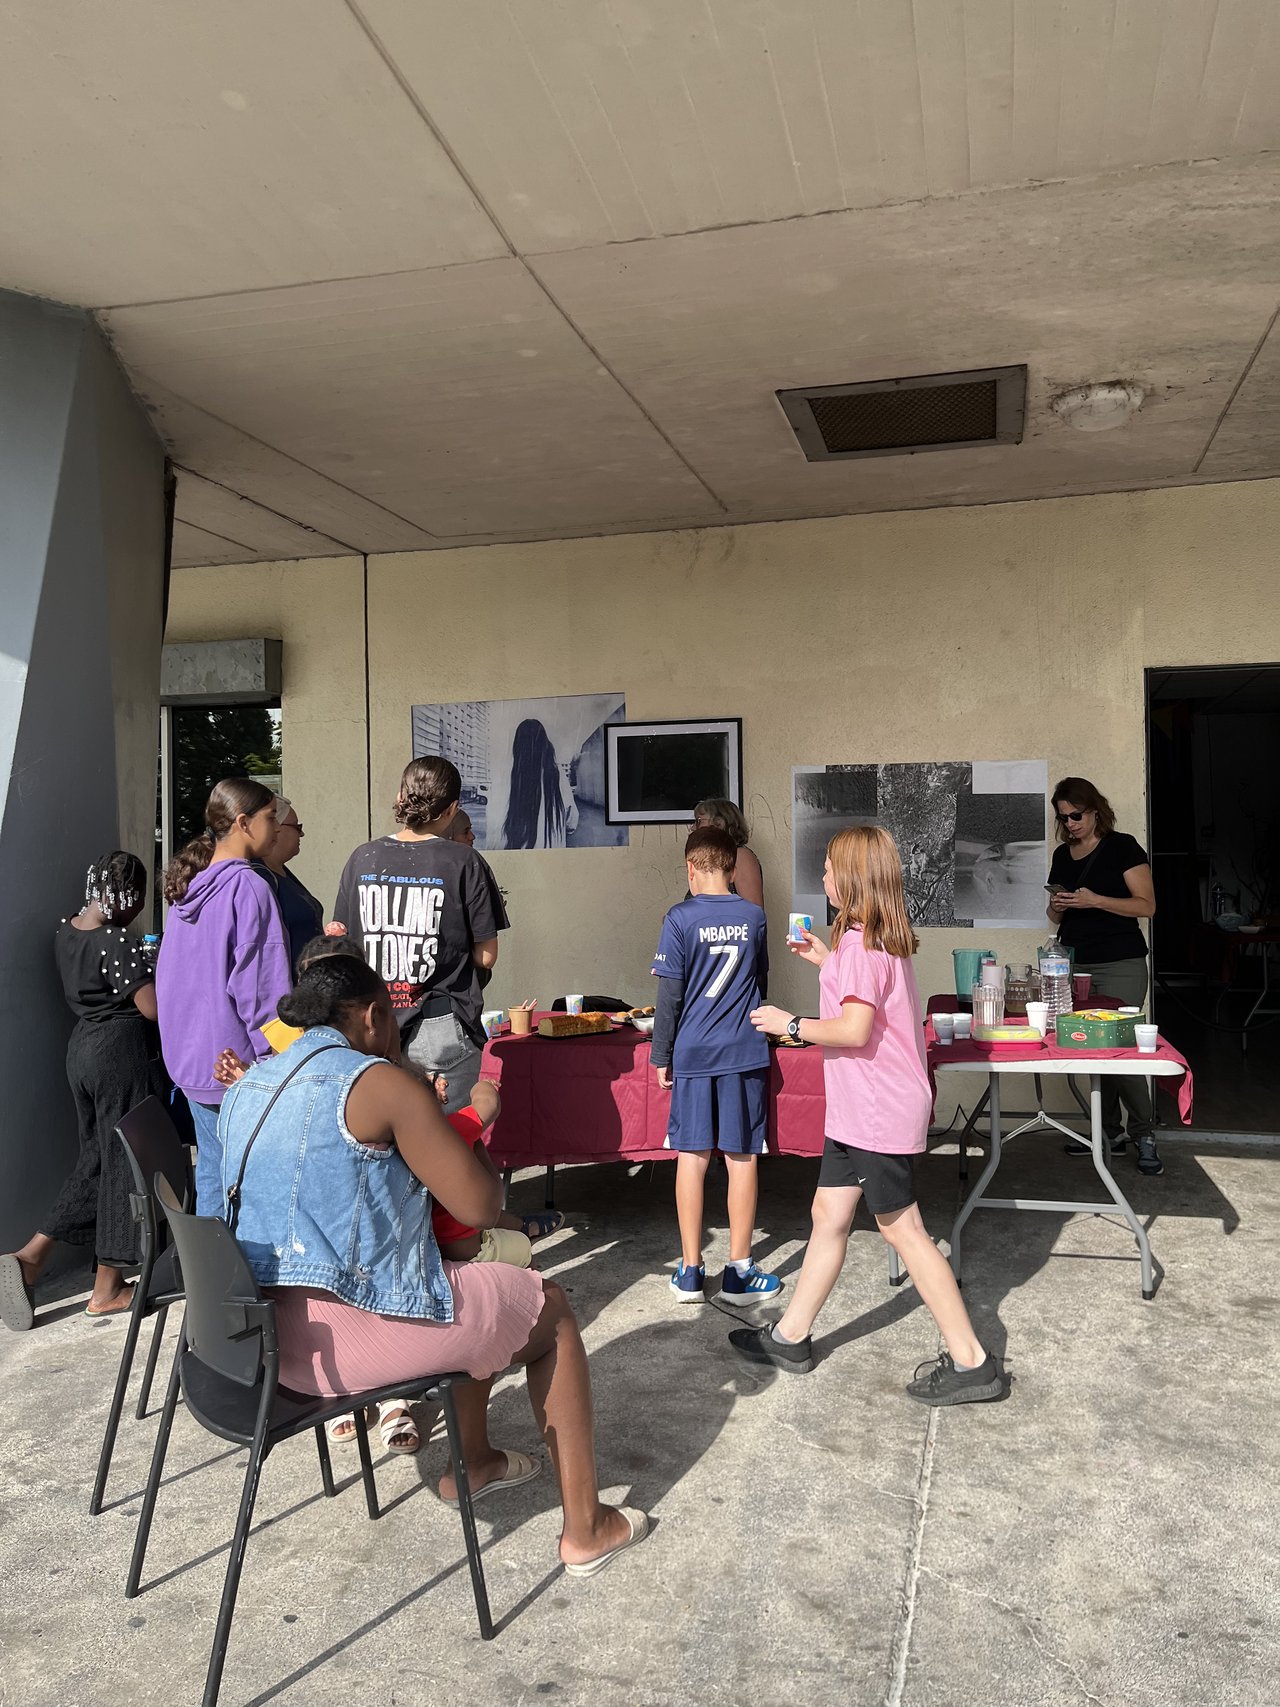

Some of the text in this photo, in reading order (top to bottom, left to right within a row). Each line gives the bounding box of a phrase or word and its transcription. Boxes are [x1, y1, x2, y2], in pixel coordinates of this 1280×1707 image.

[380, 875, 444, 885] FABULOUS
[358, 884, 445, 936] ROLLING
[699, 923, 749, 943] MBAPPÉ
[363, 934, 437, 984] TONES
[704, 944, 739, 998] 7
